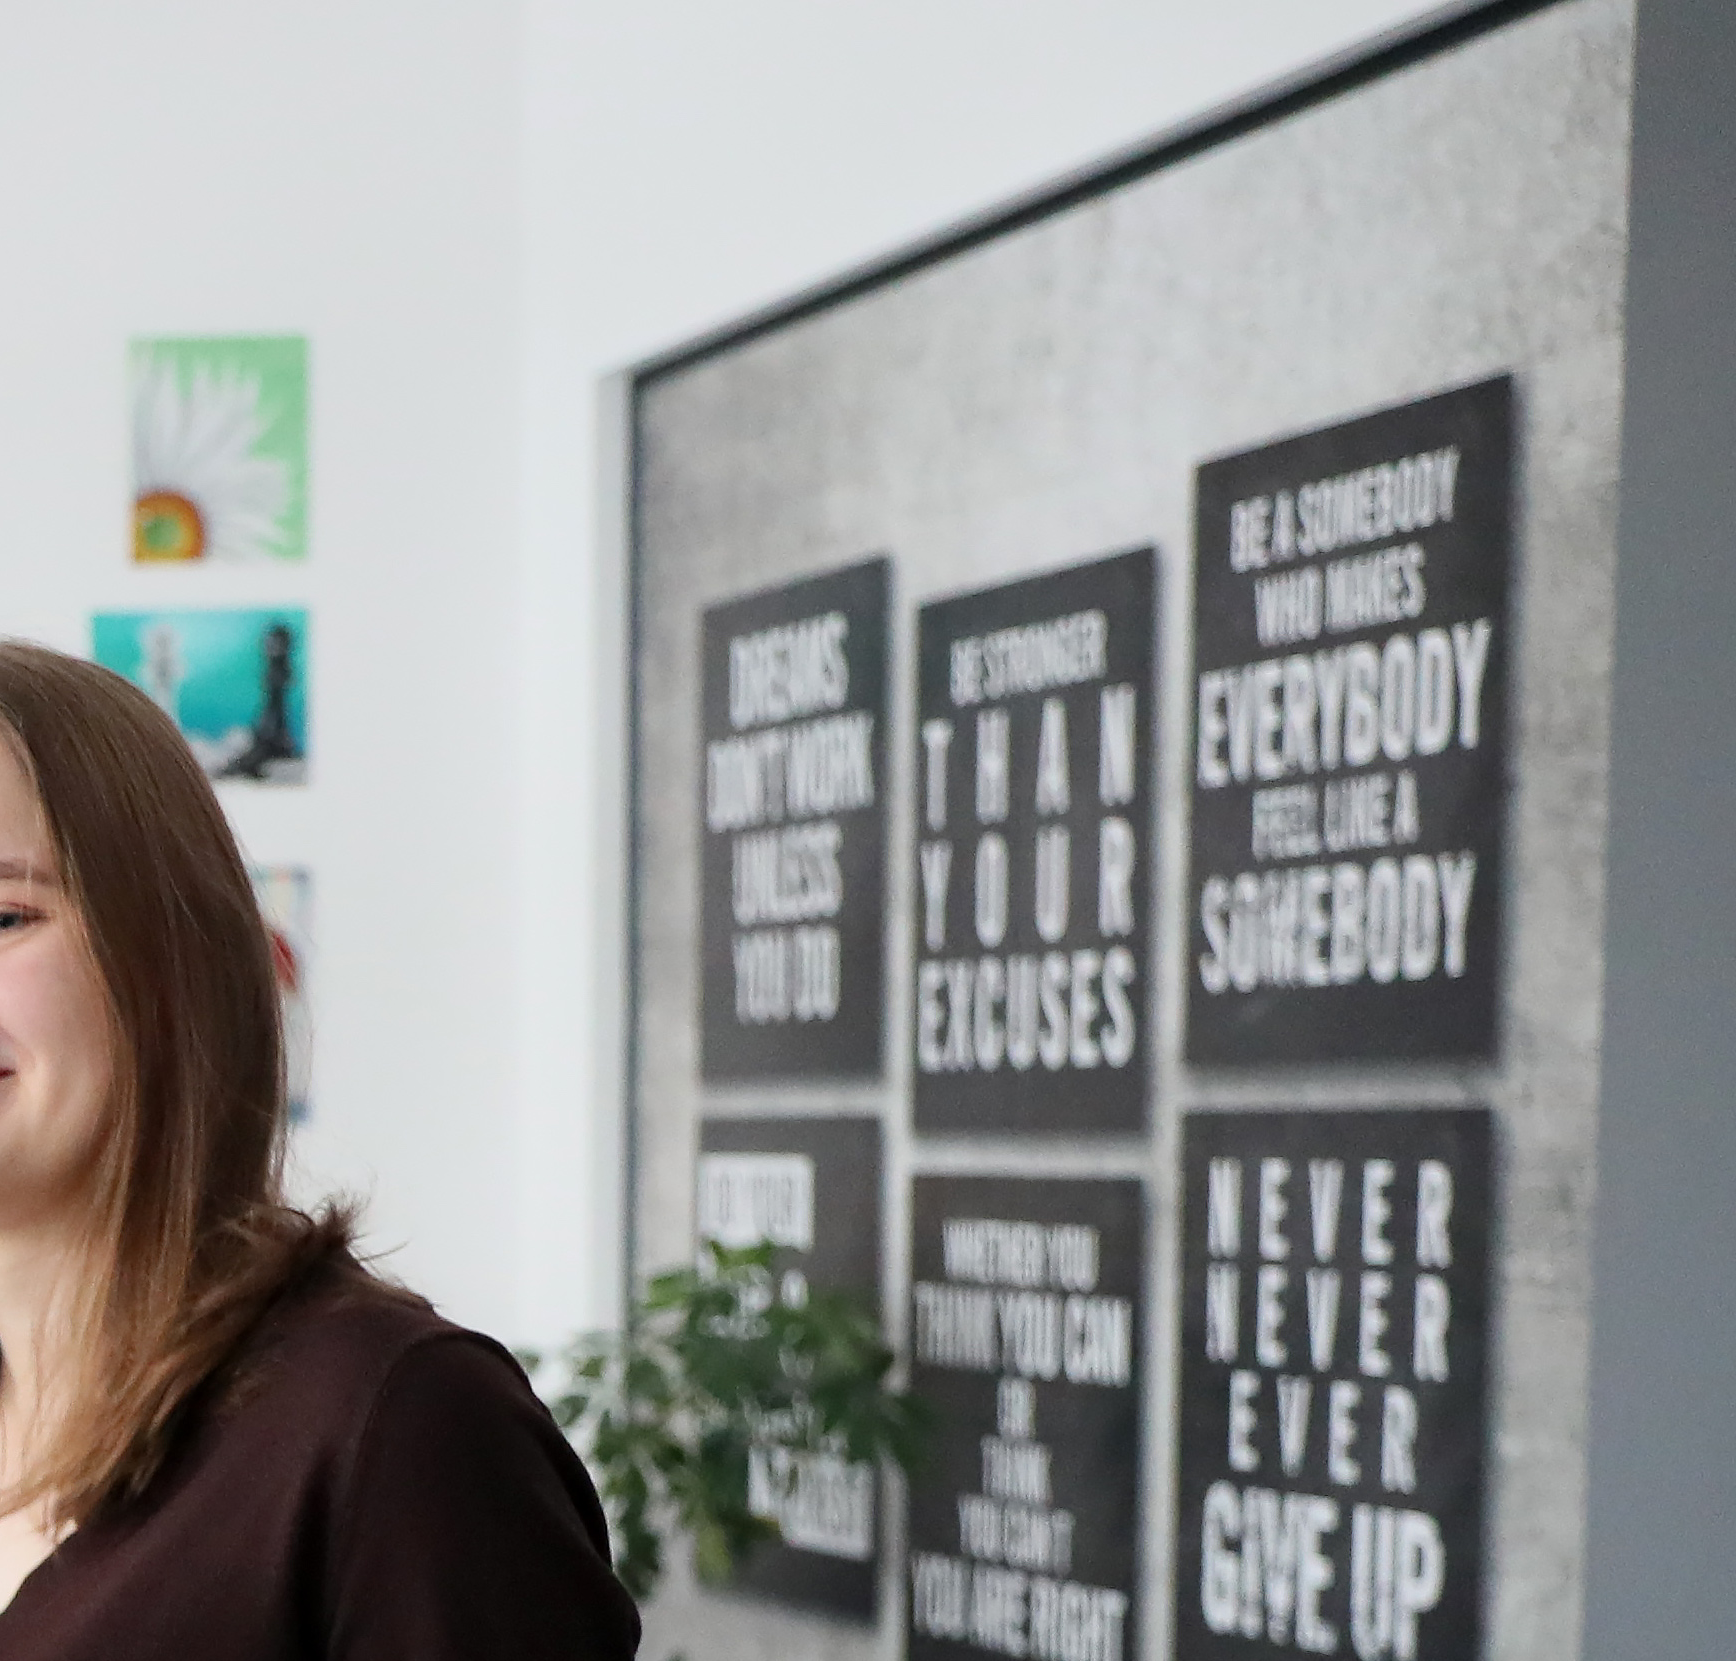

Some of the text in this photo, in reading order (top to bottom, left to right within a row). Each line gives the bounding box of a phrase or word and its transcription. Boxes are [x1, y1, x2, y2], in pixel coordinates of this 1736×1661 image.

[1230, 446, 1461, 574] BE A SOMEBODY
[1255, 543, 1426, 648] WHO MAKES
[922, 682, 1135, 831] THAN
[1196, 618, 1491, 789] EVERYBODY
[1394, 768, 1420, 845] A
[921, 816, 1134, 951] YOUR
[1198, 850, 1477, 996] SOMEBODY
[917, 945, 1135, 1073] EXCUSES
[1207, 1156, 1453, 1268] NEVER
[1204, 1261, 1452, 1384] NEVER
[1228, 1368, 1419, 1495] EVER
[1200, 1478, 1340, 1657] GIVE
